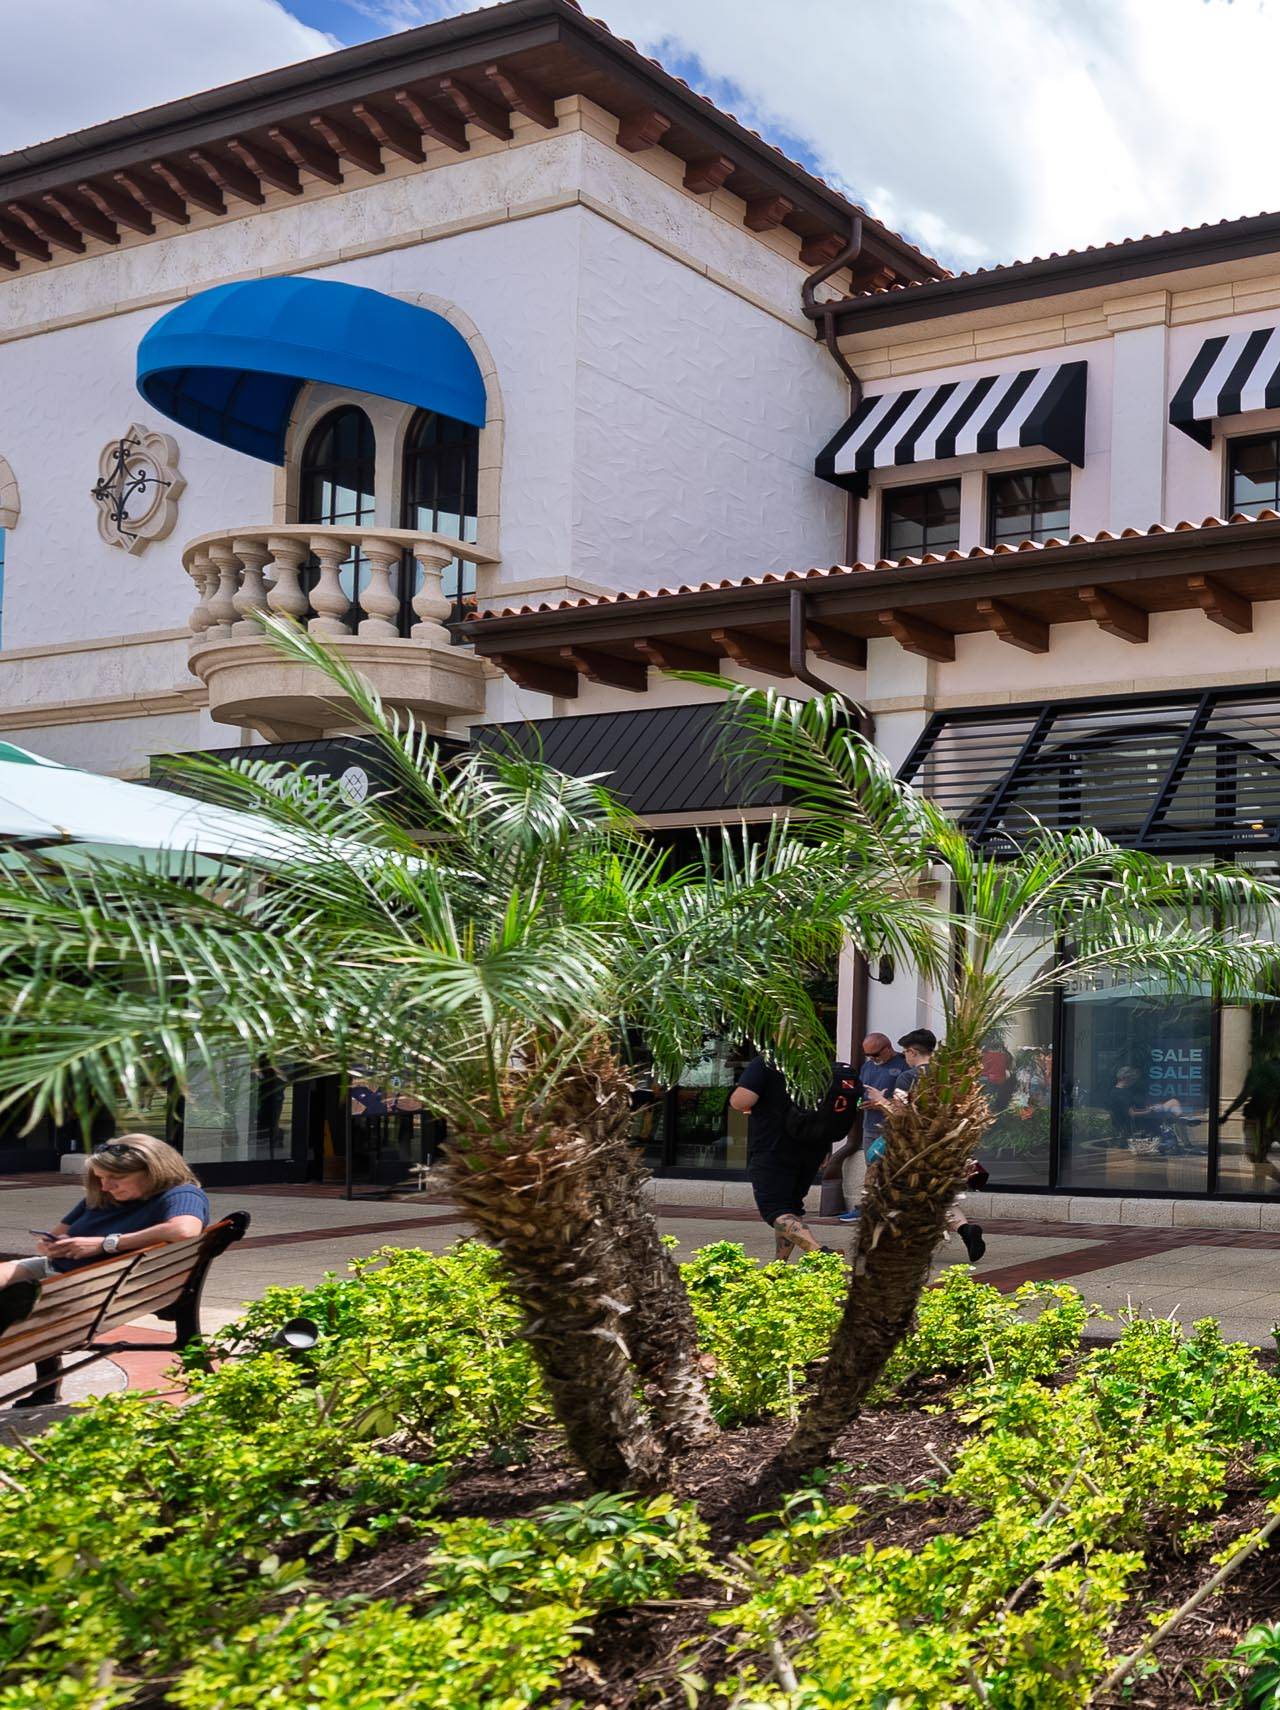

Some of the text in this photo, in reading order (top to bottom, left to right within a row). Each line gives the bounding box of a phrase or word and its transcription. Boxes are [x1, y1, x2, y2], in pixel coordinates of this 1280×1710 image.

[1151, 1049, 1202, 1062] SALE
[1149, 1066, 1202, 1080] SALE
[1149, 1084, 1201, 1097] SALE
